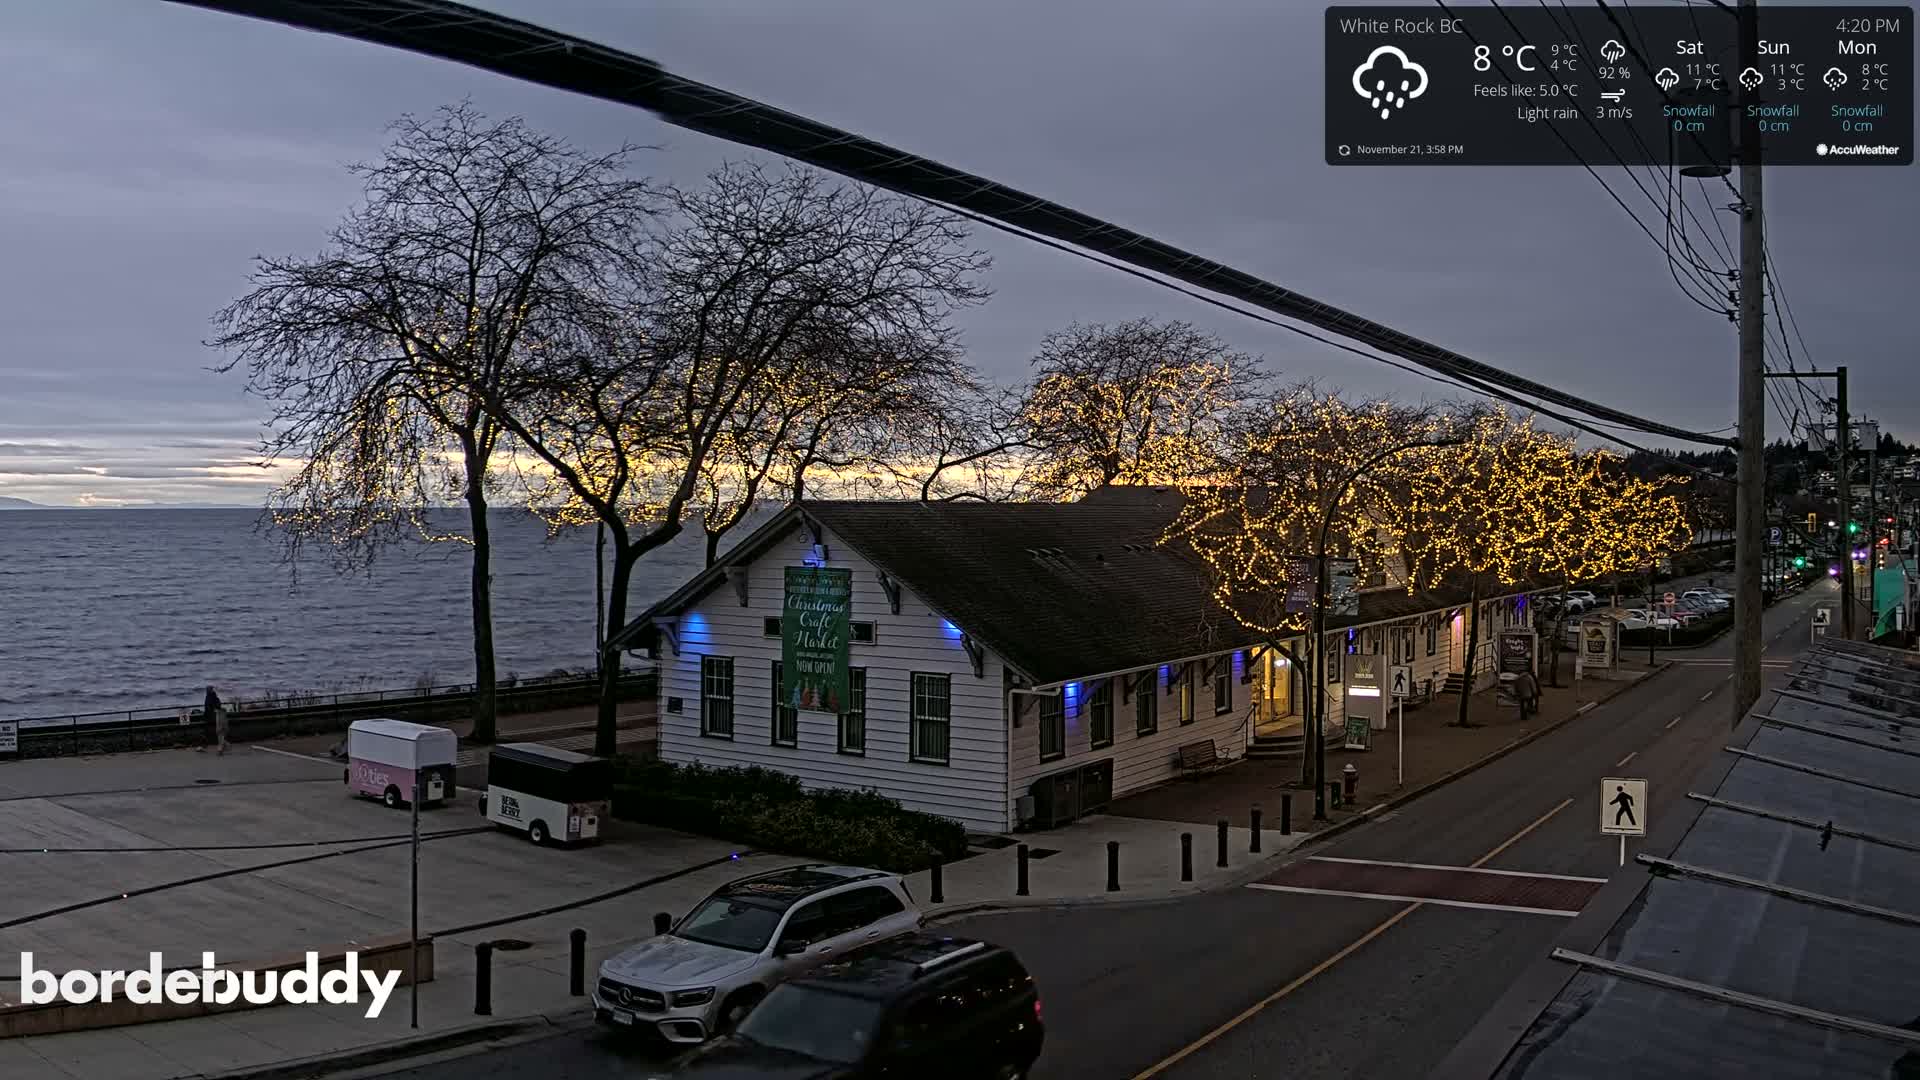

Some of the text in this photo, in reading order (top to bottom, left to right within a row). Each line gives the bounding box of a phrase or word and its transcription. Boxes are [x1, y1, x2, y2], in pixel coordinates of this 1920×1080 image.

[788, 594, 844, 612] Christmas
[800, 611, 833, 637] Craft
[793, 630, 840, 648] Market
